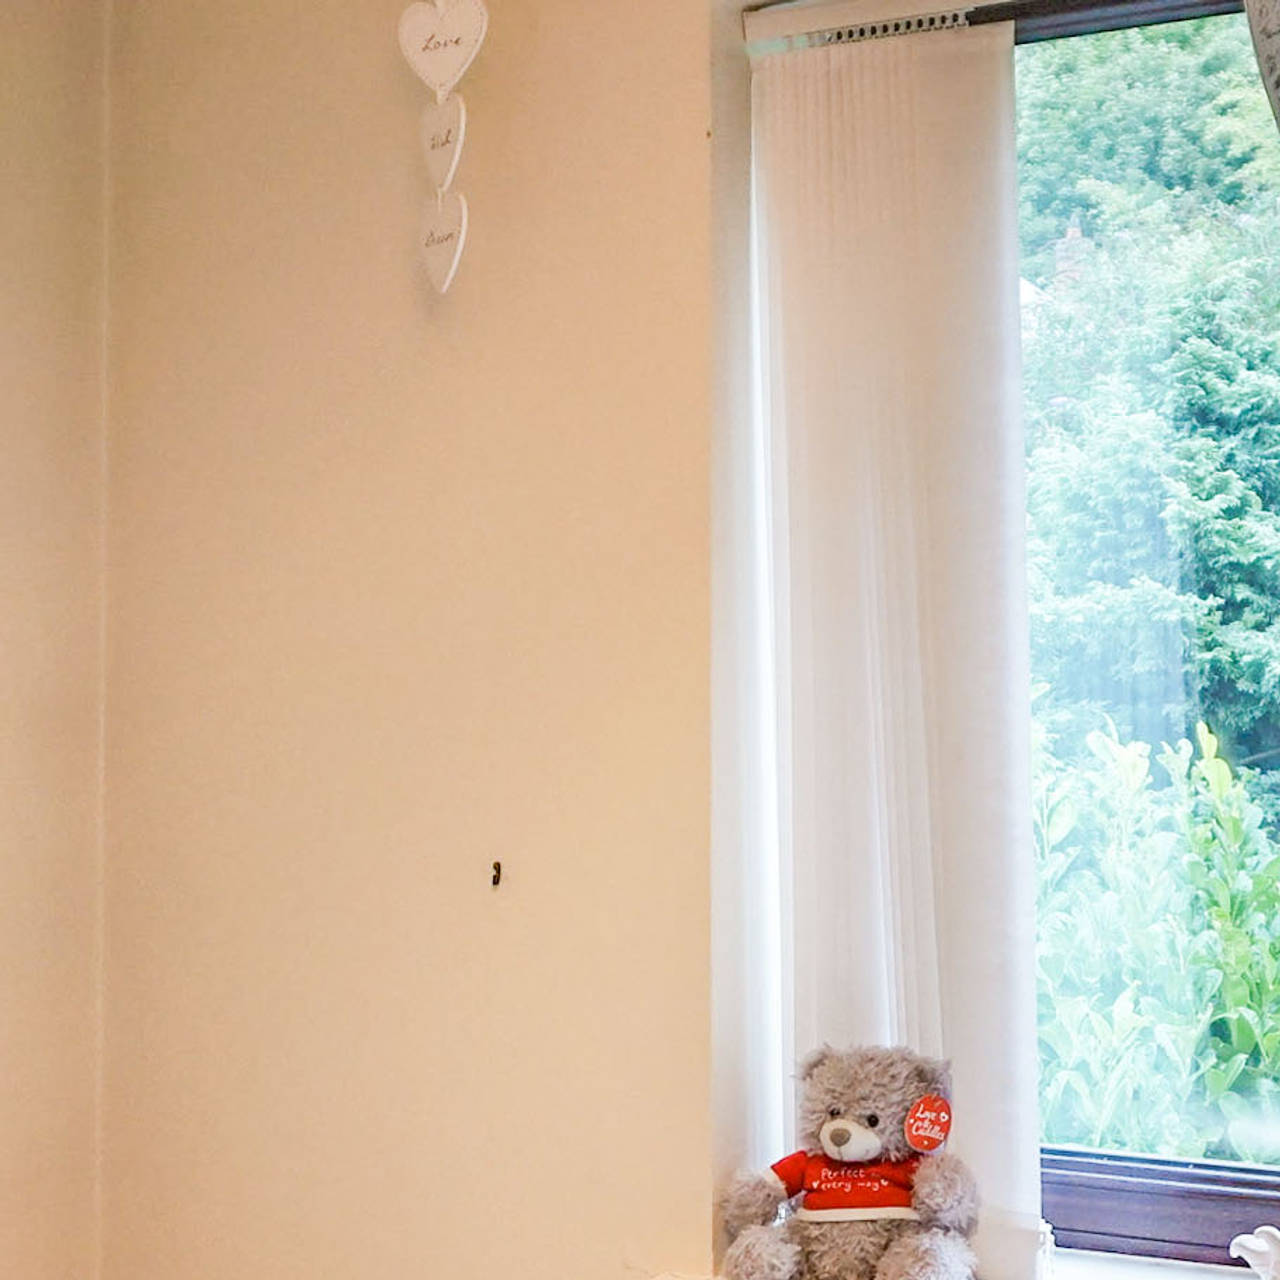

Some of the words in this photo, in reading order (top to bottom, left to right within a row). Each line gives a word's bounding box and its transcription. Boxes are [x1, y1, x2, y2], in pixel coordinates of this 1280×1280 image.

[422, 33, 462, 52] Love
[915, 1103, 937, 1120] Love
[821, 1167, 866, 1181] Perfect
[821, 1181, 852, 1193] every
